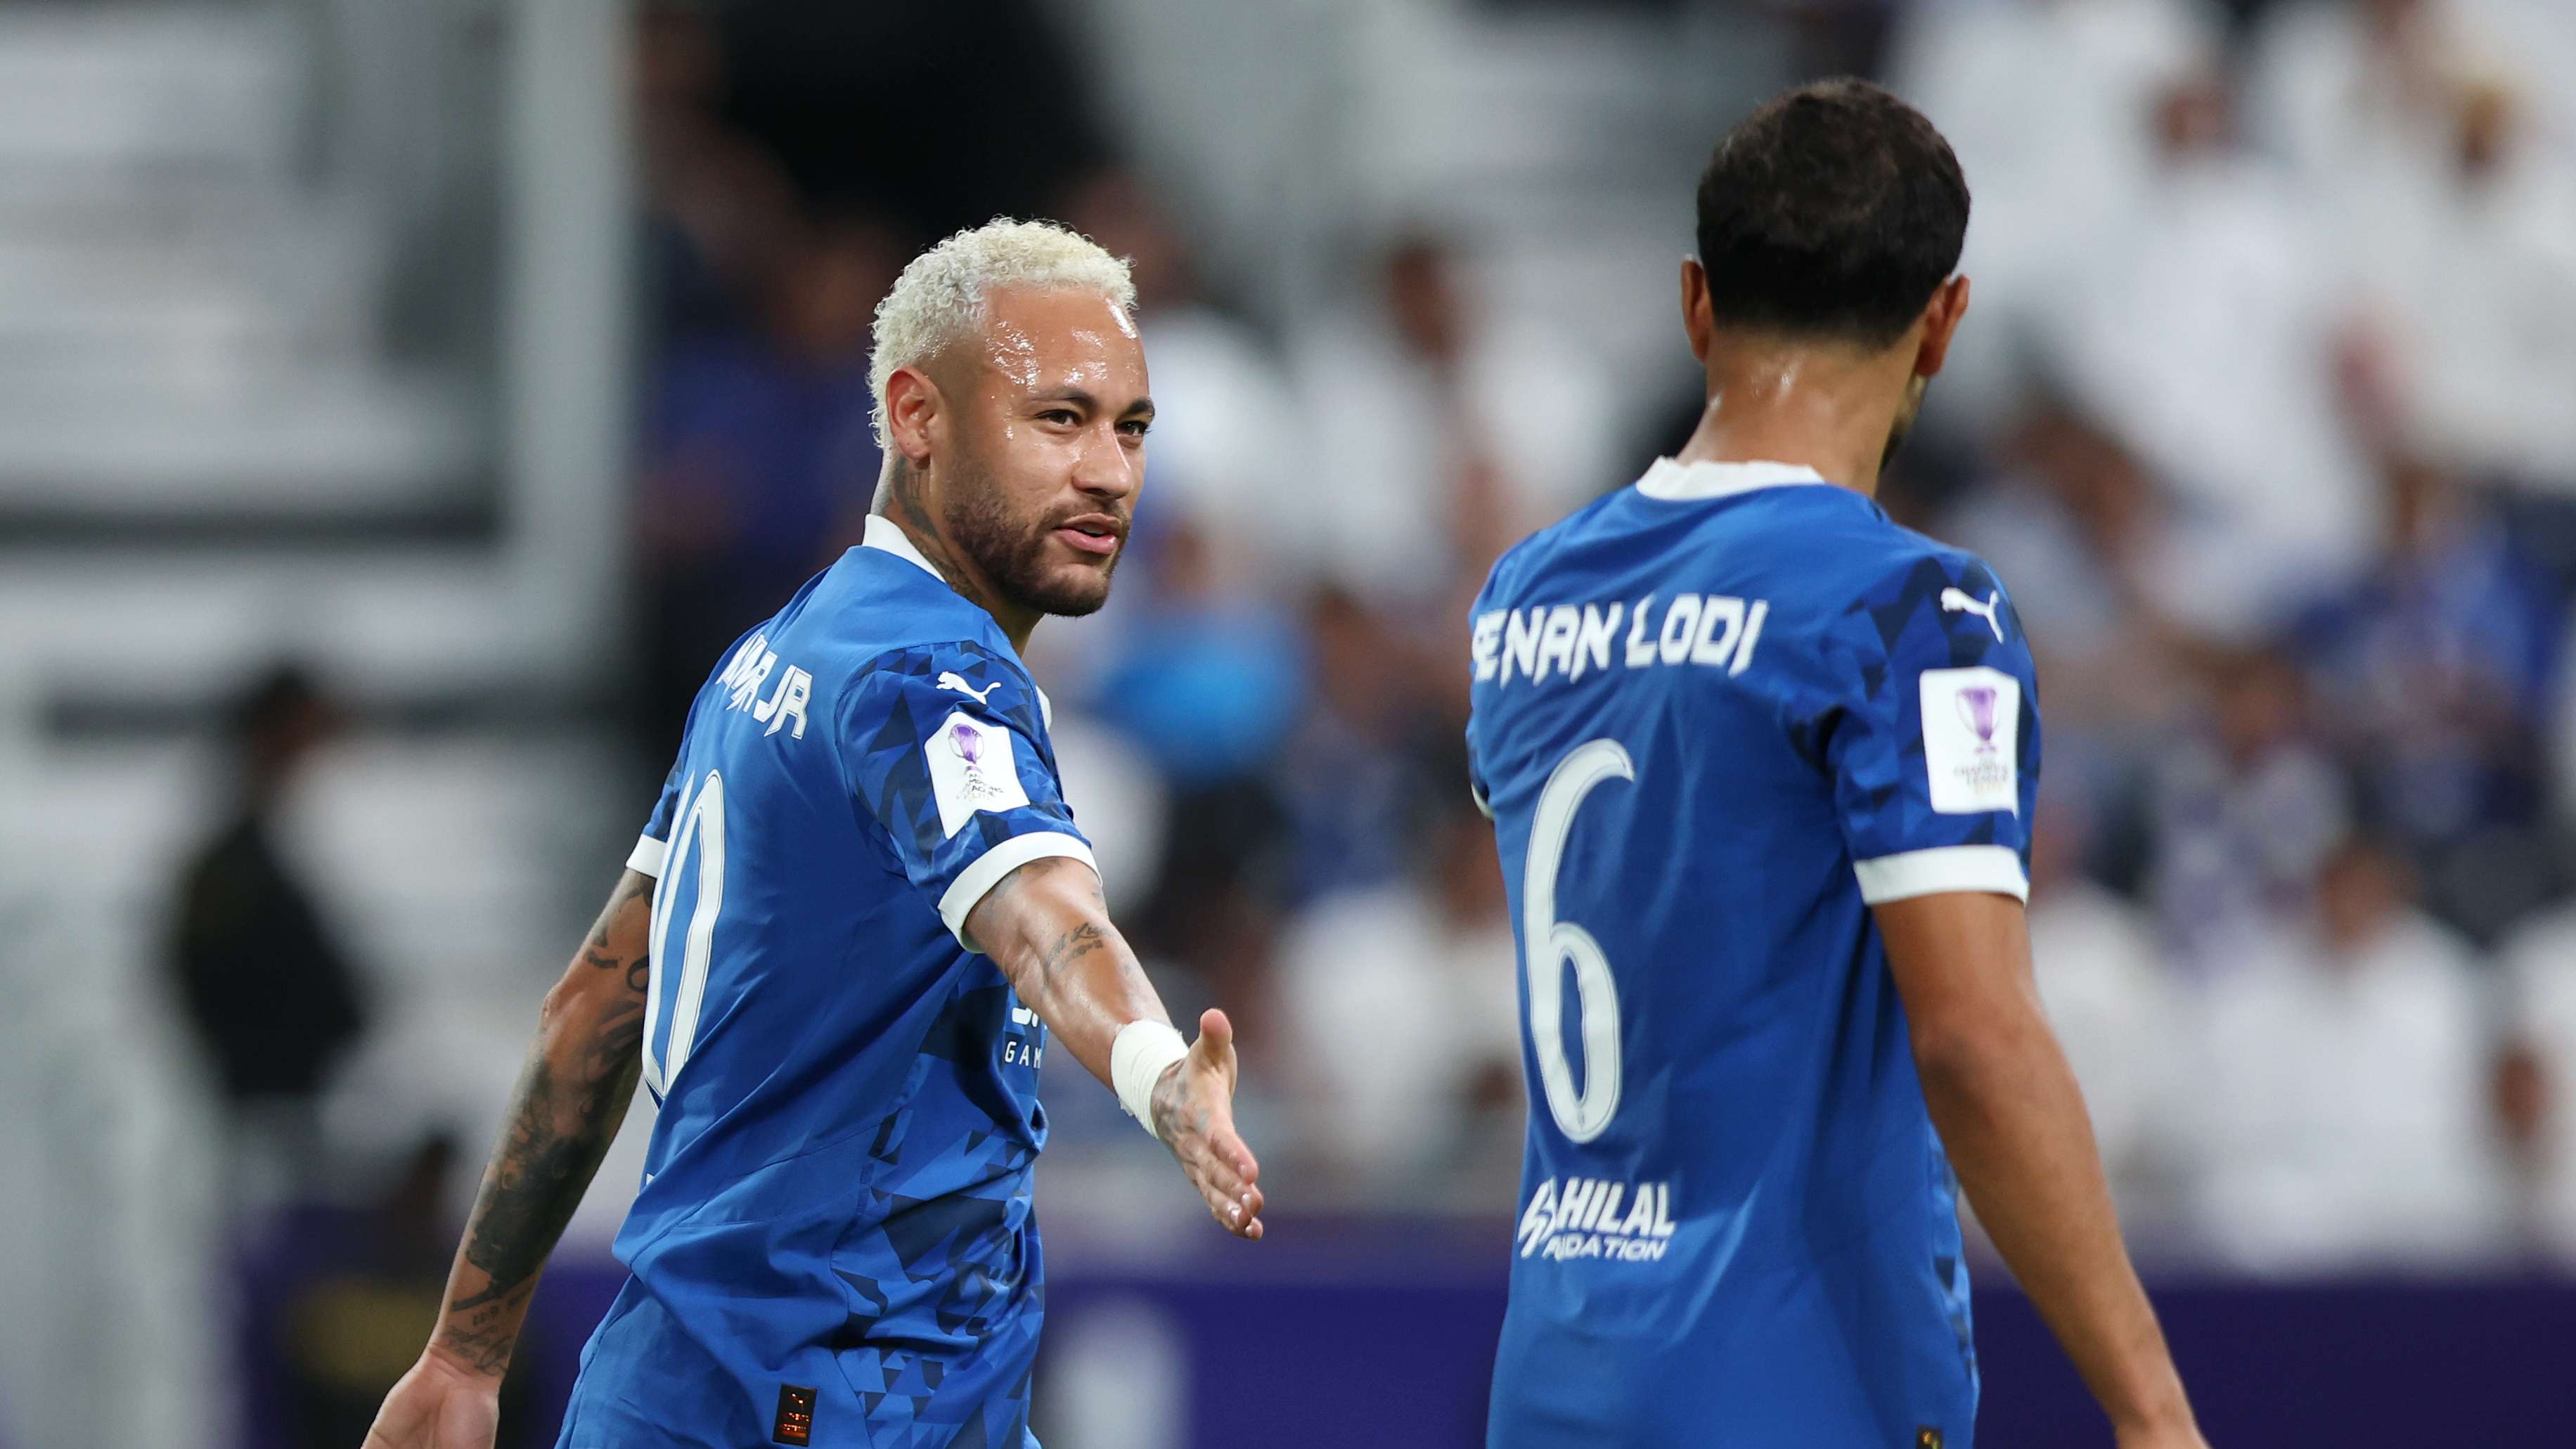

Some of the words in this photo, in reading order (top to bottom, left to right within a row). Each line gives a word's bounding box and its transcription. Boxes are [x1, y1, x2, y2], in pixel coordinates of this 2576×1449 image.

[1624, 591, 1769, 678] LODI
[753, 664, 813, 740] JR
[1523, 738, 1635, 1144] 6
